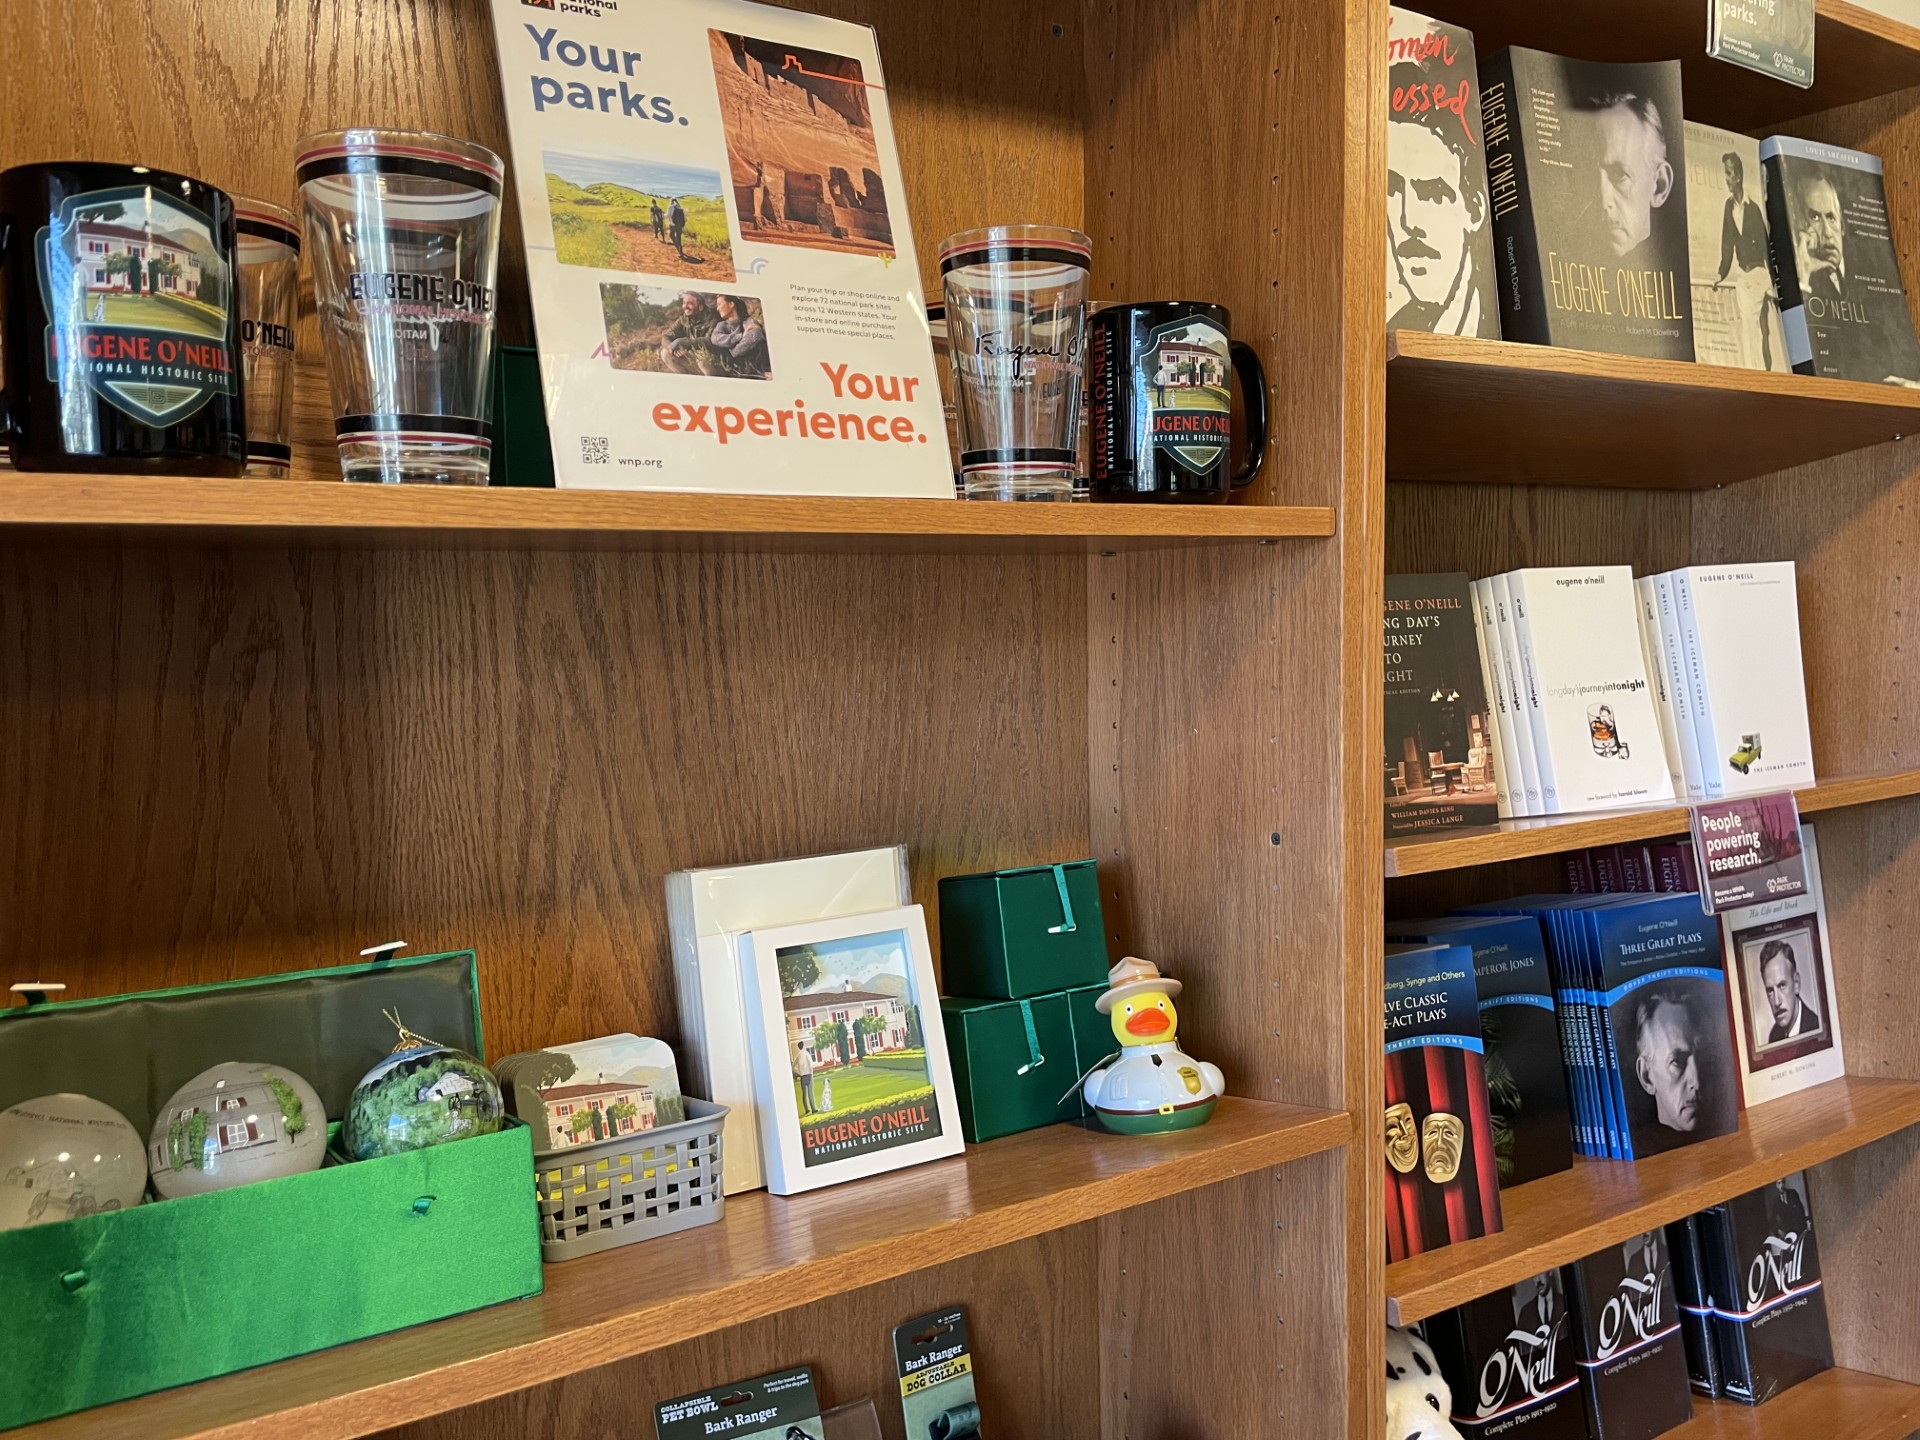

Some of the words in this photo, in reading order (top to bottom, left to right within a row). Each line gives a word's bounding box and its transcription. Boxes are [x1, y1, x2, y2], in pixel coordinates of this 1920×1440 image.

[560, 2, 601, 18] parks
[1723, 2, 1757, 26] parks.
[523, 23, 642, 77] Your
[1389, 31, 1461, 66] men
[1782, 61, 1806, 78] PROTECTOR
[1784, 55, 1794, 64] PARK
[530, 74, 690, 127] parks.
[1392, 80, 1477, 148] essed
[1481, 82, 1510, 151] EUGENE
[1805, 144, 1825, 157] LOUIS
[1827, 148, 1860, 165] SHEAFFER
[1488, 152, 1519, 221] O'NEILL
[1506, 235, 1516, 266] Robert
[1511, 275, 1521, 312] Dowling
[350, 272, 444, 303] EUGENE
[789, 283, 806, 292] Plan
[806, 286, 823, 295] your
[824, 287, 837, 296] trip
[847, 290, 865, 299] shop
[865, 292, 886, 301] online
[1548, 251, 1613, 316] EUGENE
[1616, 268, 1684, 320] O'NEILL
[791, 295, 819, 304] explore
[820, 296, 829, 304] 72
[829, 299, 858, 307] national
[859, 301, 874, 310] park
[875, 303, 891, 311] sites
[793, 305, 816, 313] across
[818, 306, 826, 314] 12
[827, 307, 857, 317] Western
[857, 311, 881, 320] states.
[881, 313, 897, 321] Your
[1808, 296, 1870, 324] O'NEILL
[795, 315, 823, 323] in-store
[824, 317, 838, 325] and
[839, 319, 861, 327] online
[861, 321, 896, 330] purchases
[796, 325, 825, 334] support
[826, 328, 846, 336] these
[847, 329, 870, 339] special
[872, 331, 896, 340] places.
[1626, 325, 1645, 336] Robert
[1653, 326, 1680, 342] Dowling
[158, 340, 233, 374] O'NEILL
[1094, 322, 1107, 400] O'NEILL
[141, 365, 203, 382] HISTORIC
[208, 374, 229, 387] SITE
[819, 362, 919, 403] Your
[1106, 360, 1114, 412] HISTORIC
[652, 398, 928, 445] experience.
[1096, 403, 1107, 480] EUGENE
[1153, 434, 1189, 443] ATIONAL
[1193, 434, 1223, 443] HISTORIC
[618, 456, 664, 469] wnp.org
[1556, 578, 1583, 588] eugene
[1584, 575, 1606, 585] o'neill
[1699, 574, 1726, 583] EUGENE
[1727, 573, 1754, 581] O'NEILL
[1414, 598, 1462, 611] O'NEILL
[1660, 583, 1669, 616] O'NEILL
[1679, 578, 1688, 611] O'NEILL
[1406, 615, 1441, 629] DAY'S
[1671, 651, 1680, 684] ICEMAN
[1690, 647, 1700, 680] ICEMAN
[1618, 790, 1633, 798] harold
[1633, 788, 1648, 797] bloom
[1689, 784, 1702, 792] Yale
[1707, 781, 1721, 789] Yale
[1391, 810, 1418, 819] WILLIAM
[1413, 818, 1440, 829] JESSICA
[1442, 814, 1464, 824] LANGE
[1702, 811, 1742, 833] People
[1706, 830, 1761, 857] powering
[1709, 848, 1762, 873] research.
[1715, 887, 1730, 897] Become
[1776, 881, 1802, 892] PROTECTOR
[1715, 896, 1724, 904] Park
[1724, 893, 1742, 903] Protector
[1742, 891, 1755, 900] today!
[1748, 909, 1759, 919] His
[1760, 905, 1772, 917] Life
[1774, 903, 1783, 913] and
[1785, 899, 1799, 911] Work
[1638, 924, 1658, 933] Eugene
[1659, 919, 1678, 929] O'Neill
[1490, 944, 1508, 954] O'Neill
[1620, 943, 1646, 956] THREE
[1647, 937, 1675, 951] GREAT
[1677, 932, 1702, 946] PLAYS
[1474, 963, 1508, 977] MPEROR
[1509, 957, 1535, 972] JONES
[1648, 970, 1671, 980] THRIFT
[1674, 968, 1708, 976] EDITIONS
[1405, 976, 1426, 988] Synge
[1427, 972, 1440, 982] and
[1441, 970, 1466, 981] Others
[1404, 992, 1448, 1010] CLASSIC
[1480, 997, 1503, 1008] THRIFT
[1506, 996, 1539, 1004] EDITIONS
[1416, 1008, 1447, 1024] PLAYS
[1387, 1039, 1416, 1051] THRIFT
[1421, 1036, 1463, 1046] EDITIONS
[805, 1118, 868, 1149] EUGENE
[870, 1105, 930, 1133] O'NEILL
[815, 1139, 858, 1155] NATIONAL
[862, 1128, 902, 1145] HISTORIC
[905, 1124, 925, 1135] SITE
[1746, 1229, 1807, 1313] O'Neill
[1597, 1261, 1671, 1361] O'Neill
[1752, 1313, 1771, 1328] Complete
[1770, 1308, 1782, 1319] Plays
[905, 1355, 929, 1372] Bark
[929, 1344, 963, 1363] Ranger
[1476, 1311, 1568, 1418] O'Neill
[1604, 1360, 1628, 1376] Complete
[1628, 1353, 1641, 1366] Plays
[906, 1378, 926, 1392] DOG
[928, 1363, 967, 1384] COLLAR
[915, 1361, 955, 1379] ADJUSTABLE
[763, 1381, 778, 1389] Perfect
[771, 1386, 780, 1394] trips
[791, 1380, 800, 1388] dog
[800, 1378, 810, 1386] park
[661, 1395, 712, 1413] COLLAPSIBLE
[662, 1411, 685, 1424] PET
[686, 1401, 719, 1418] BOWL
[704, 1417, 735, 1434] Bark
[735, 1407, 778, 1428] Ranger
[1484, 1419, 1514, 1436] Complete
[1514, 1413, 1530, 1426] Plays
